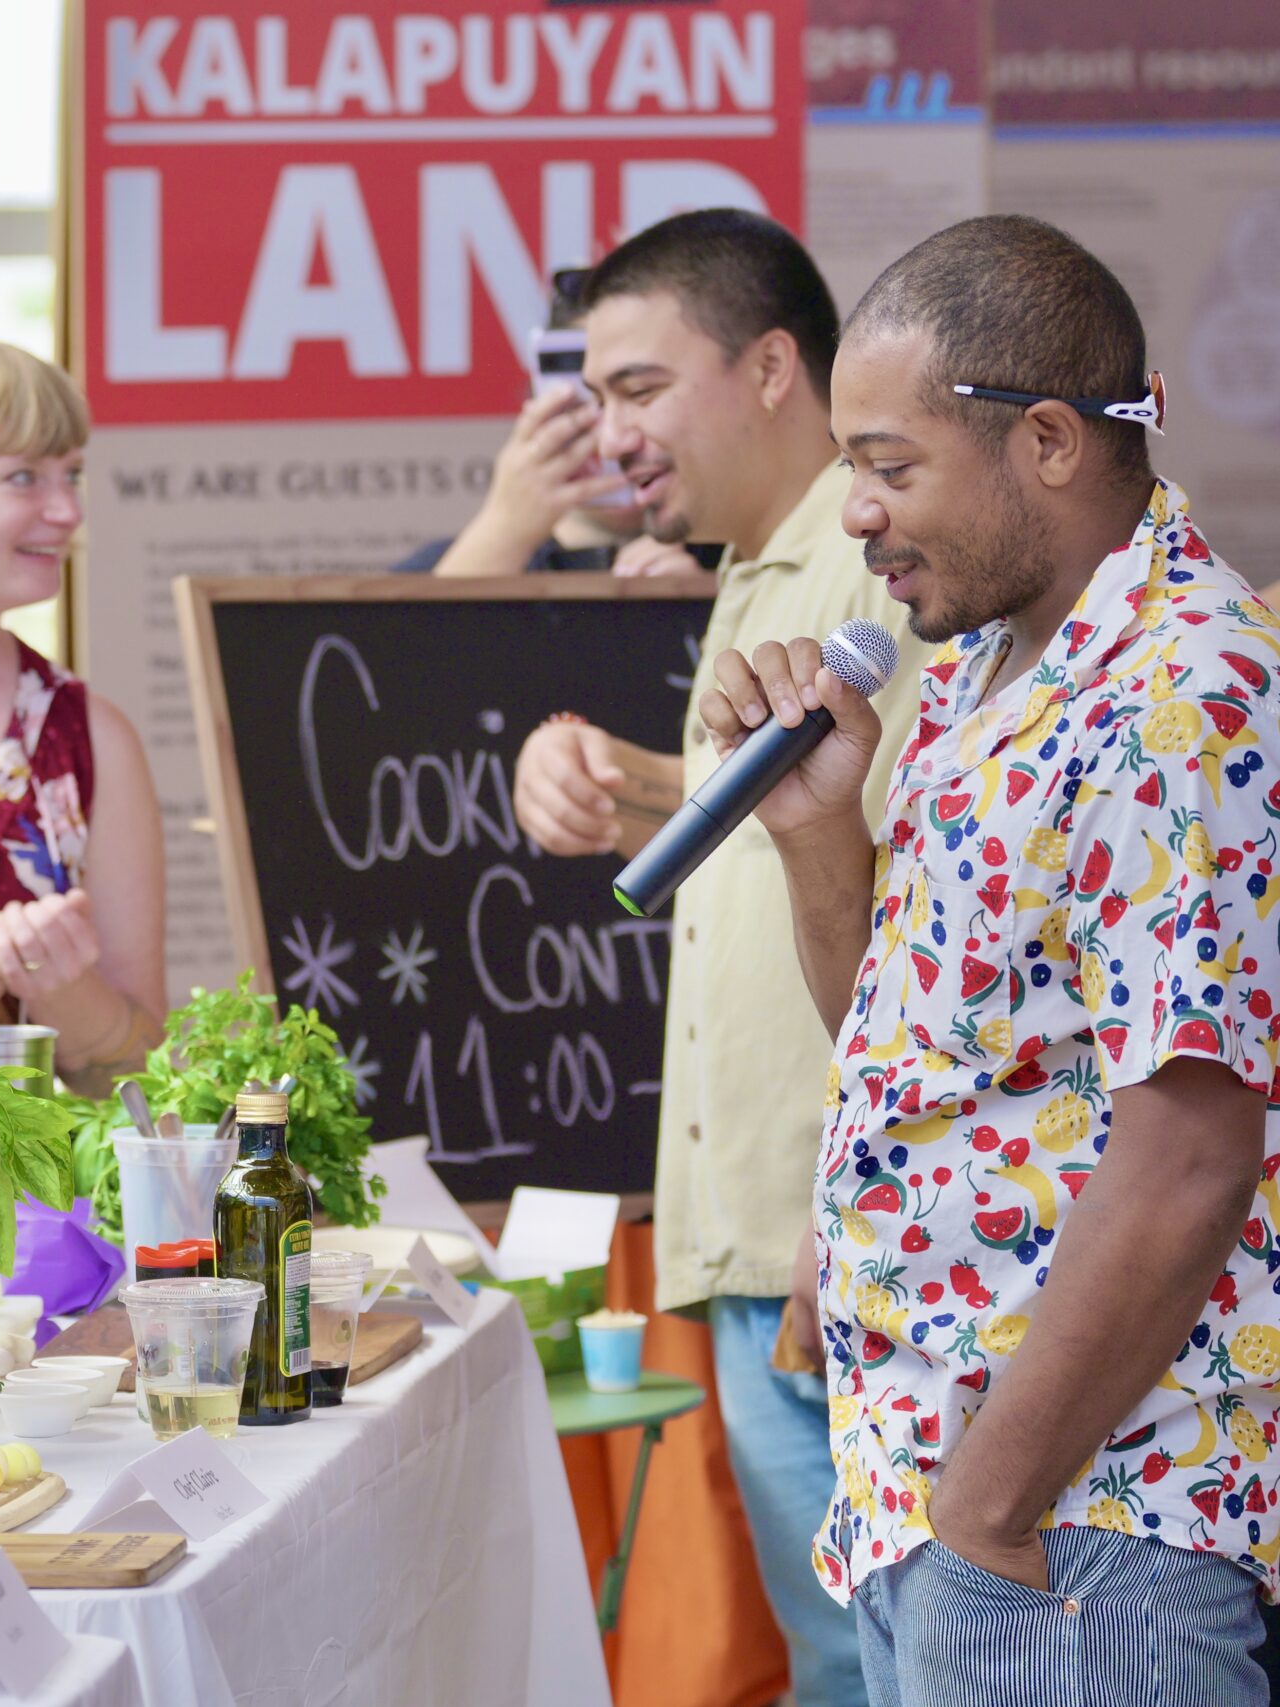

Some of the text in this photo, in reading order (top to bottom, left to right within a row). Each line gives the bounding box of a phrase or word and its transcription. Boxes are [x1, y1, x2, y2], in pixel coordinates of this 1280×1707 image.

[106, 11, 774, 118] KALAPUYAN
[112, 466, 172, 500] WE
[185, 464, 262, 497] ARE
[277, 457, 454, 497] GUESTS
